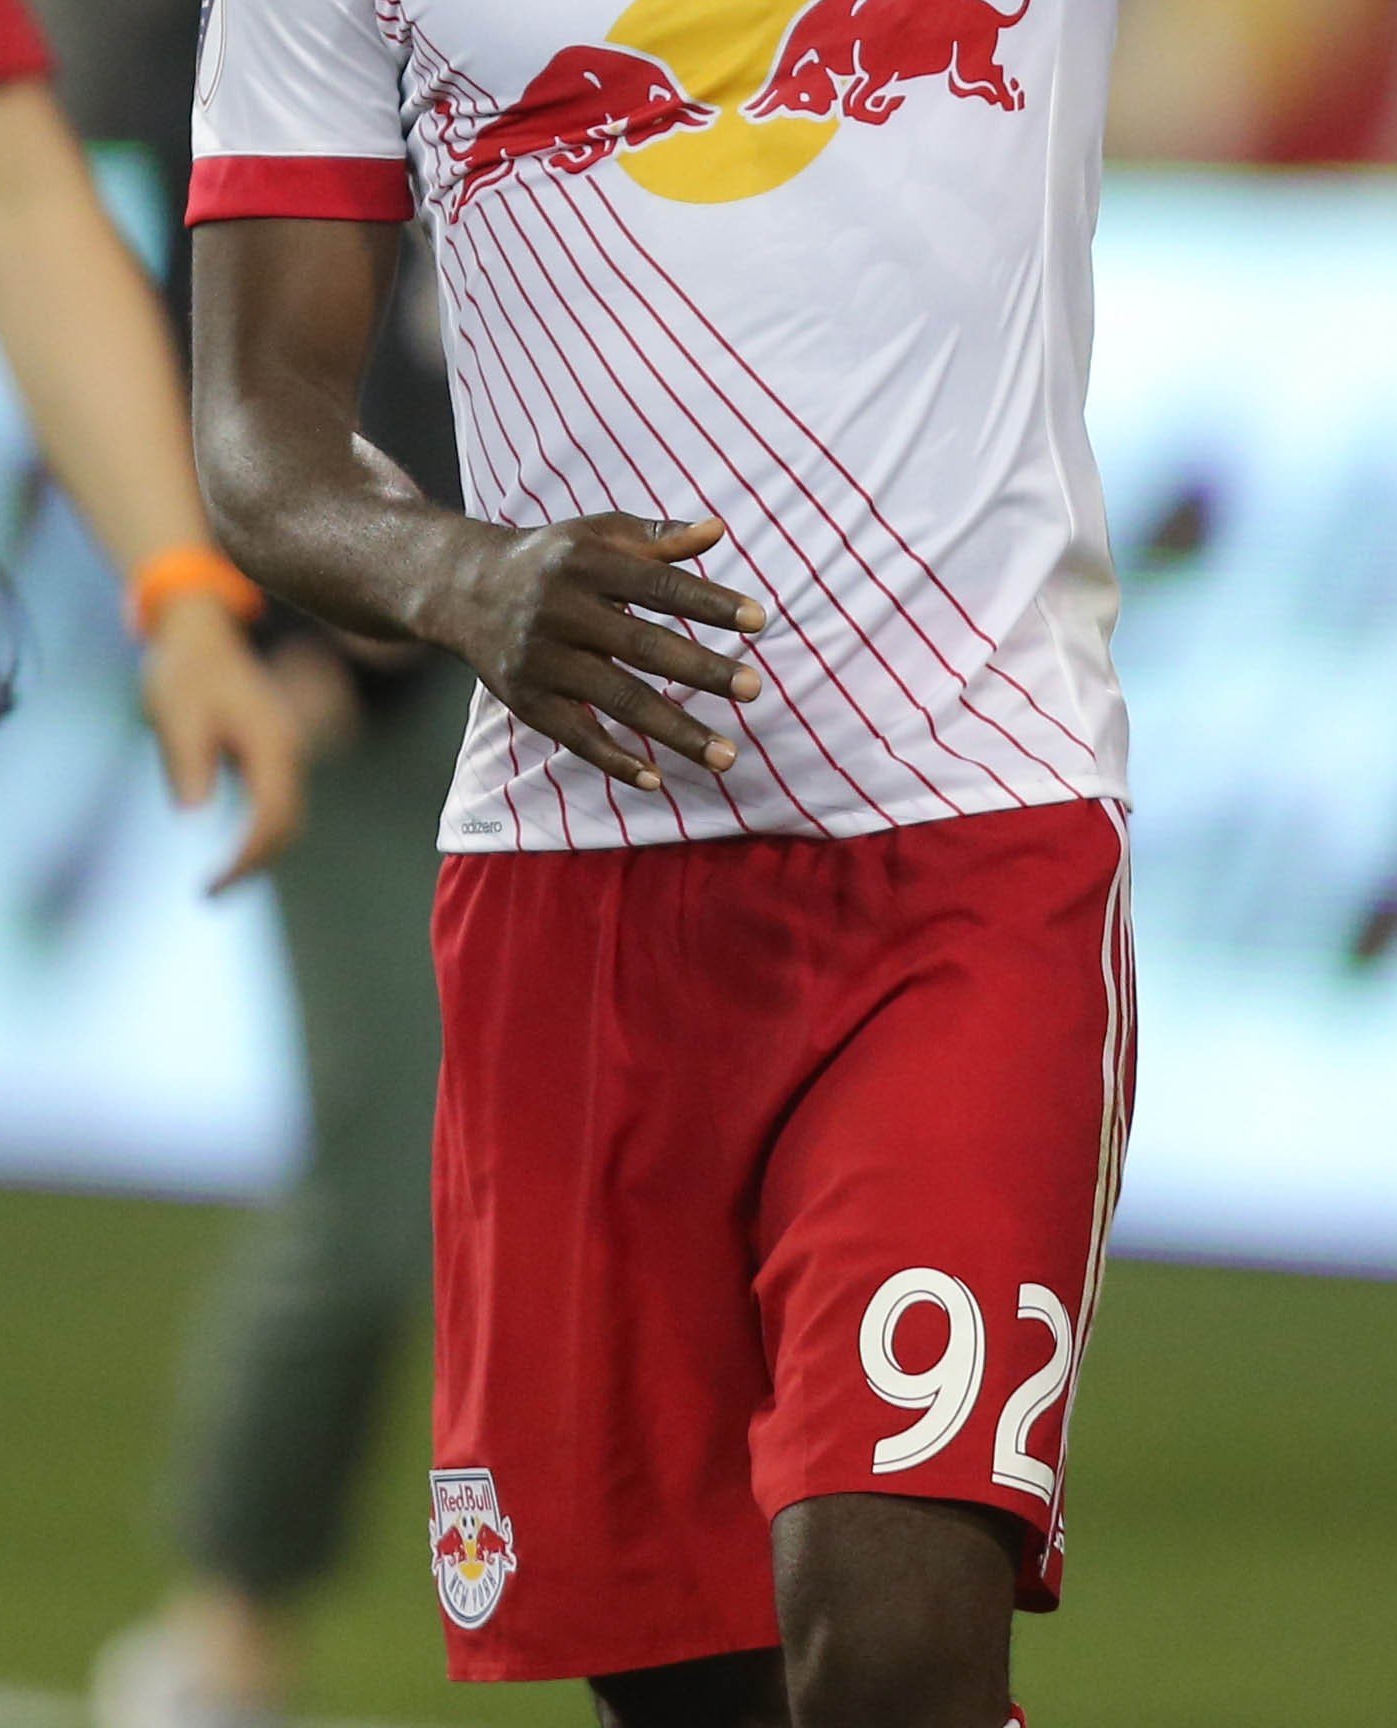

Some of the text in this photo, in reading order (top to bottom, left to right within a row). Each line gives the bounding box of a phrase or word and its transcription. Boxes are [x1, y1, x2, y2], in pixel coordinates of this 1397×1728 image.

[858, 1266, 1073, 1506] 92
[448, 1572, 497, 1610] NEW YORK
